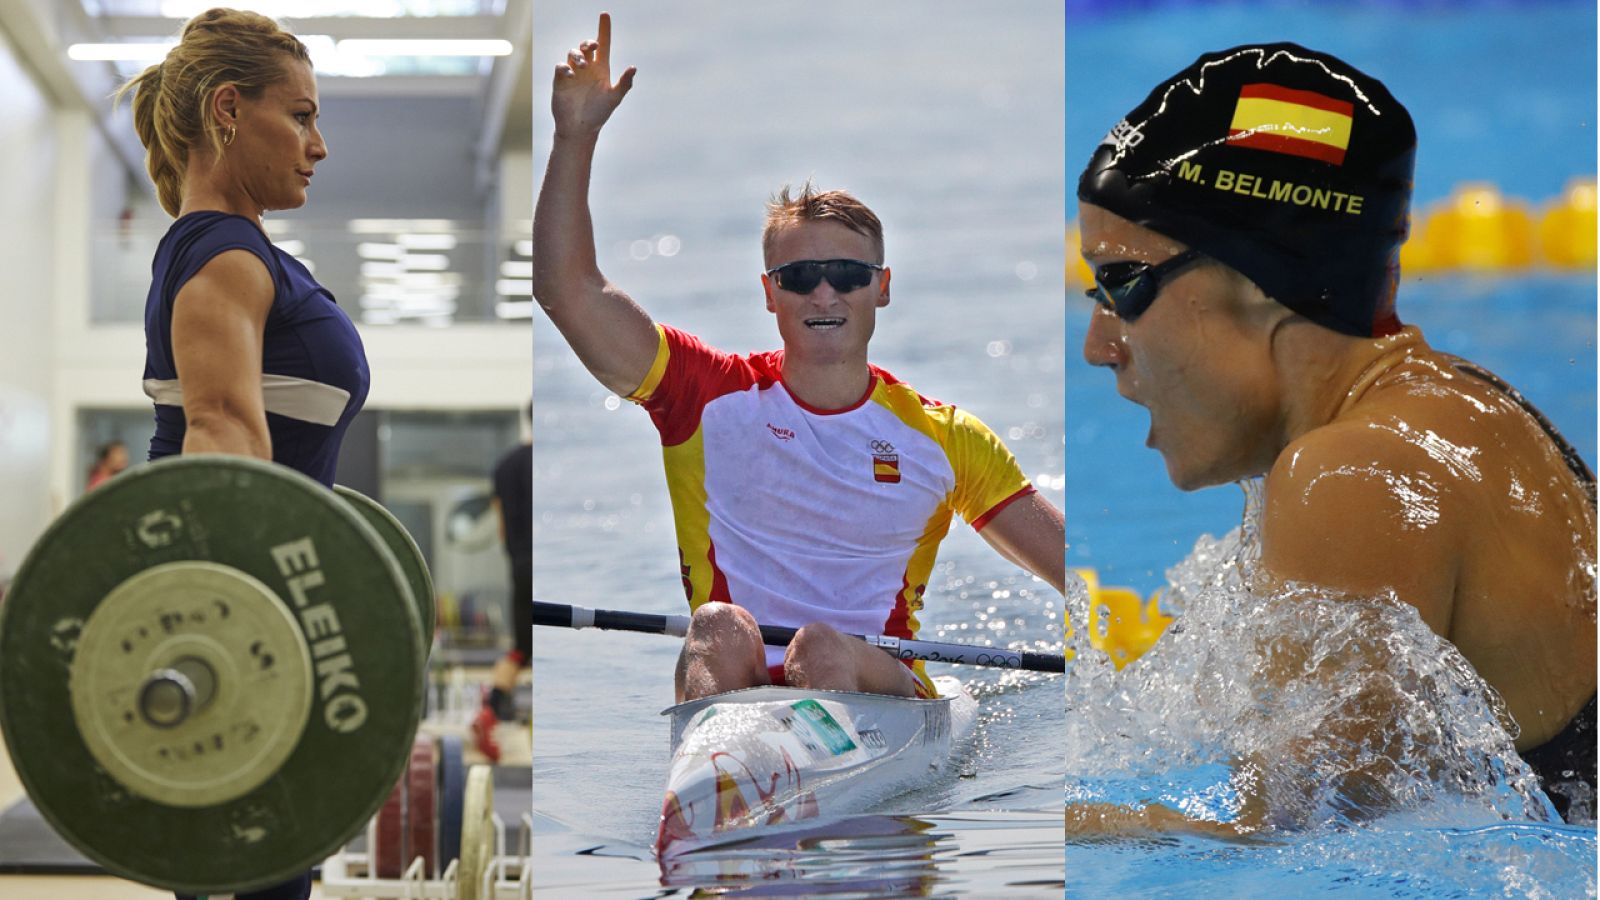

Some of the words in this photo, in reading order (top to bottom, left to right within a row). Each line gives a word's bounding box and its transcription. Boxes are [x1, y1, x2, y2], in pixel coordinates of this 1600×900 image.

[1177, 160, 1205, 185] M.
[1214, 169, 1365, 215] BELMONTE
[270, 536, 368, 733] ELEIKO
